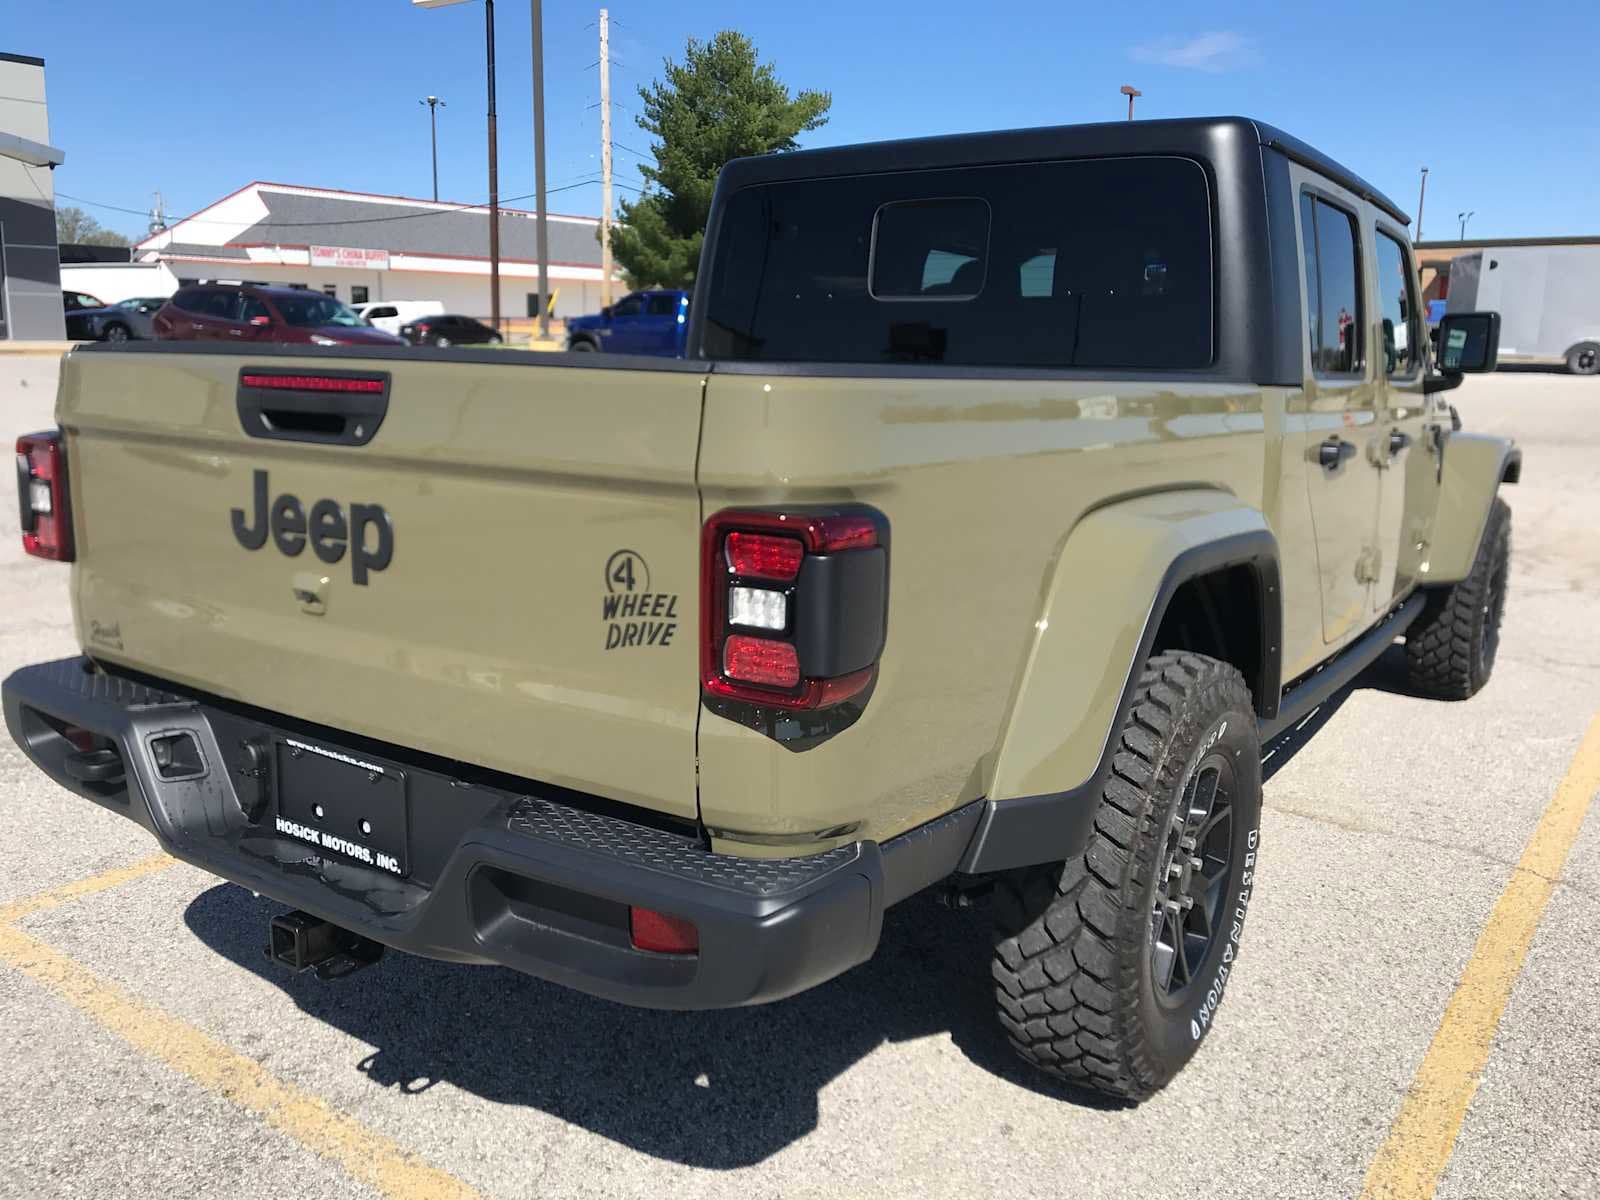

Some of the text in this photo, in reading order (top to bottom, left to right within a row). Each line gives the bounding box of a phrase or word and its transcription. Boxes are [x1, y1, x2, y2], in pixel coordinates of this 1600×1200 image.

[230, 469, 394, 586] Jeep
[613, 557, 636, 591] 4
[603, 593, 677, 620] WHEEL
[605, 621, 676, 650] DRIVE
[275, 817, 402, 874] HOSICK MOTORS, INC.
[1199, 829, 1258, 1027] DESTINATION
